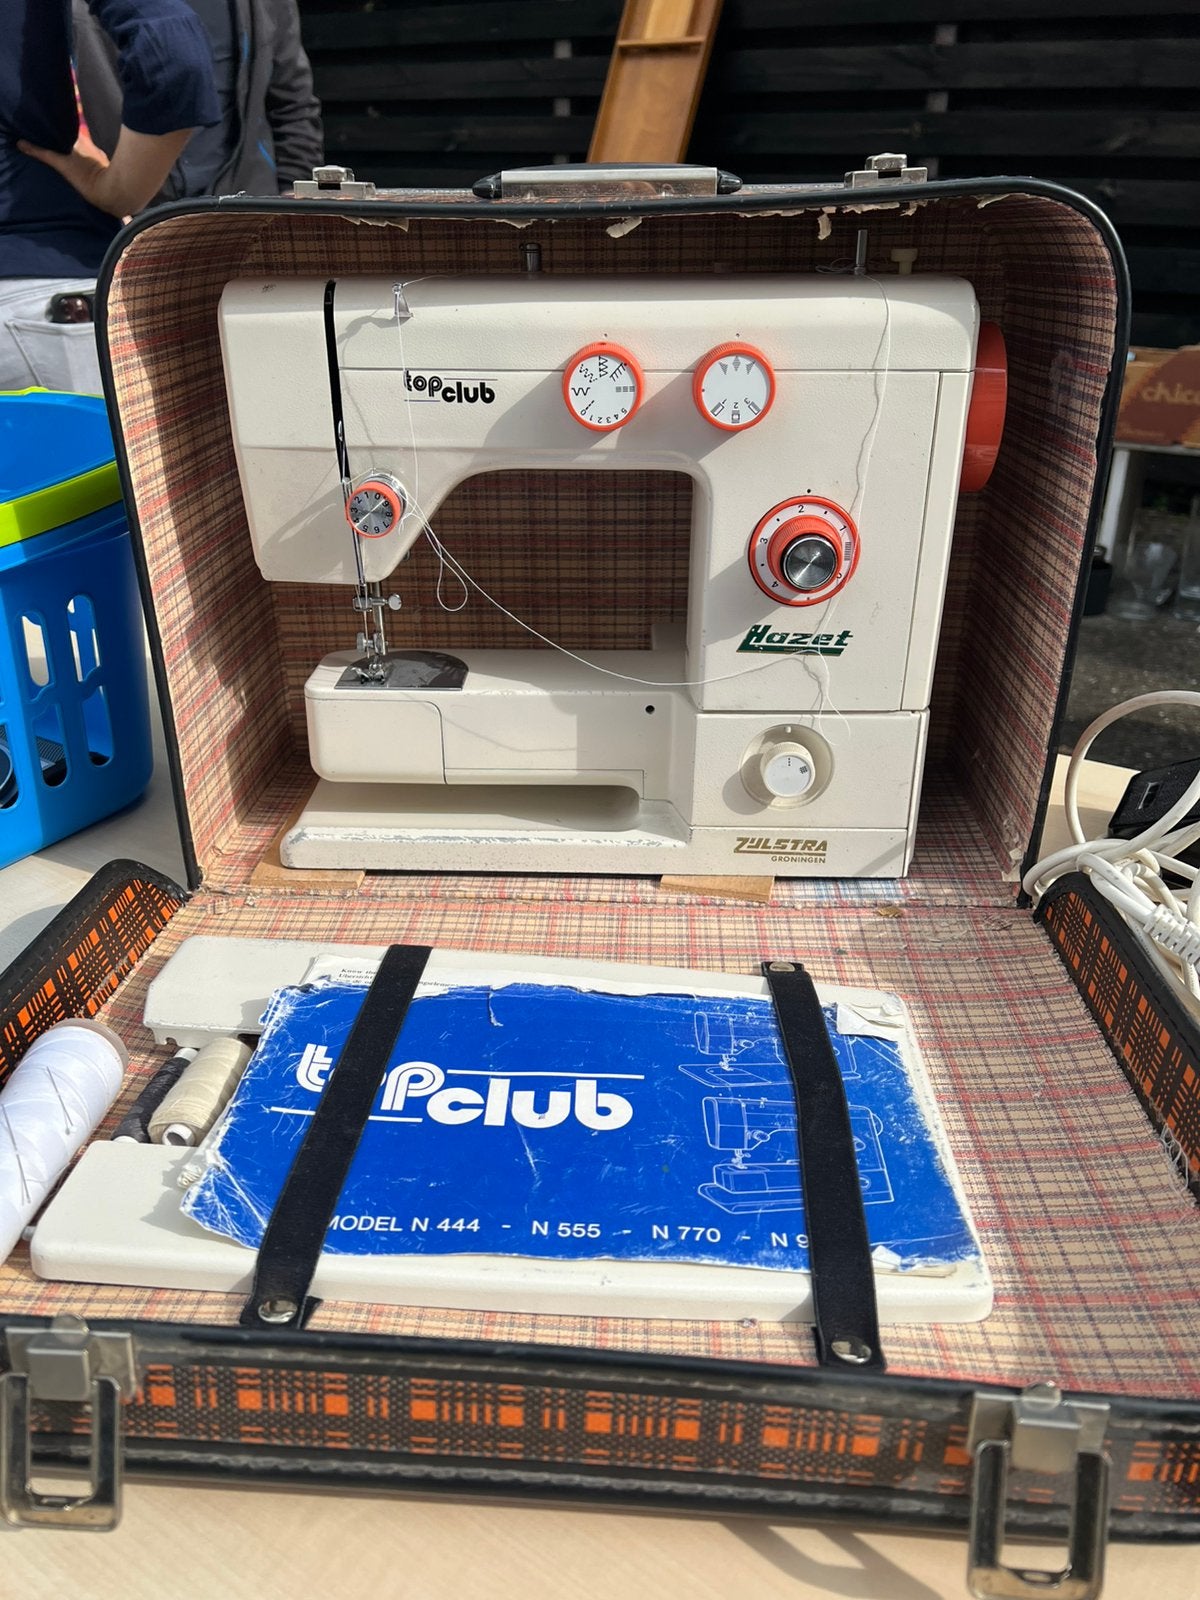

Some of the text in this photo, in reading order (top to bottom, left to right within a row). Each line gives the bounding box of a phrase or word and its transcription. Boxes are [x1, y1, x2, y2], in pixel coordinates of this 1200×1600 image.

[797, 505, 804, 513] 2
[737, 624, 854, 651] Hazet
[296, 1043, 634, 1131] tpclub
[411, 1217, 429, 1232] N
[436, 1218, 480, 1233] 444
[531, 1220, 549, 1236] N
[557, 1223, 601, 1238] 555
[652, 1224, 669, 1240] N
[678, 1226, 721, 1243] 770
[771, 1232, 789, 1248] N
